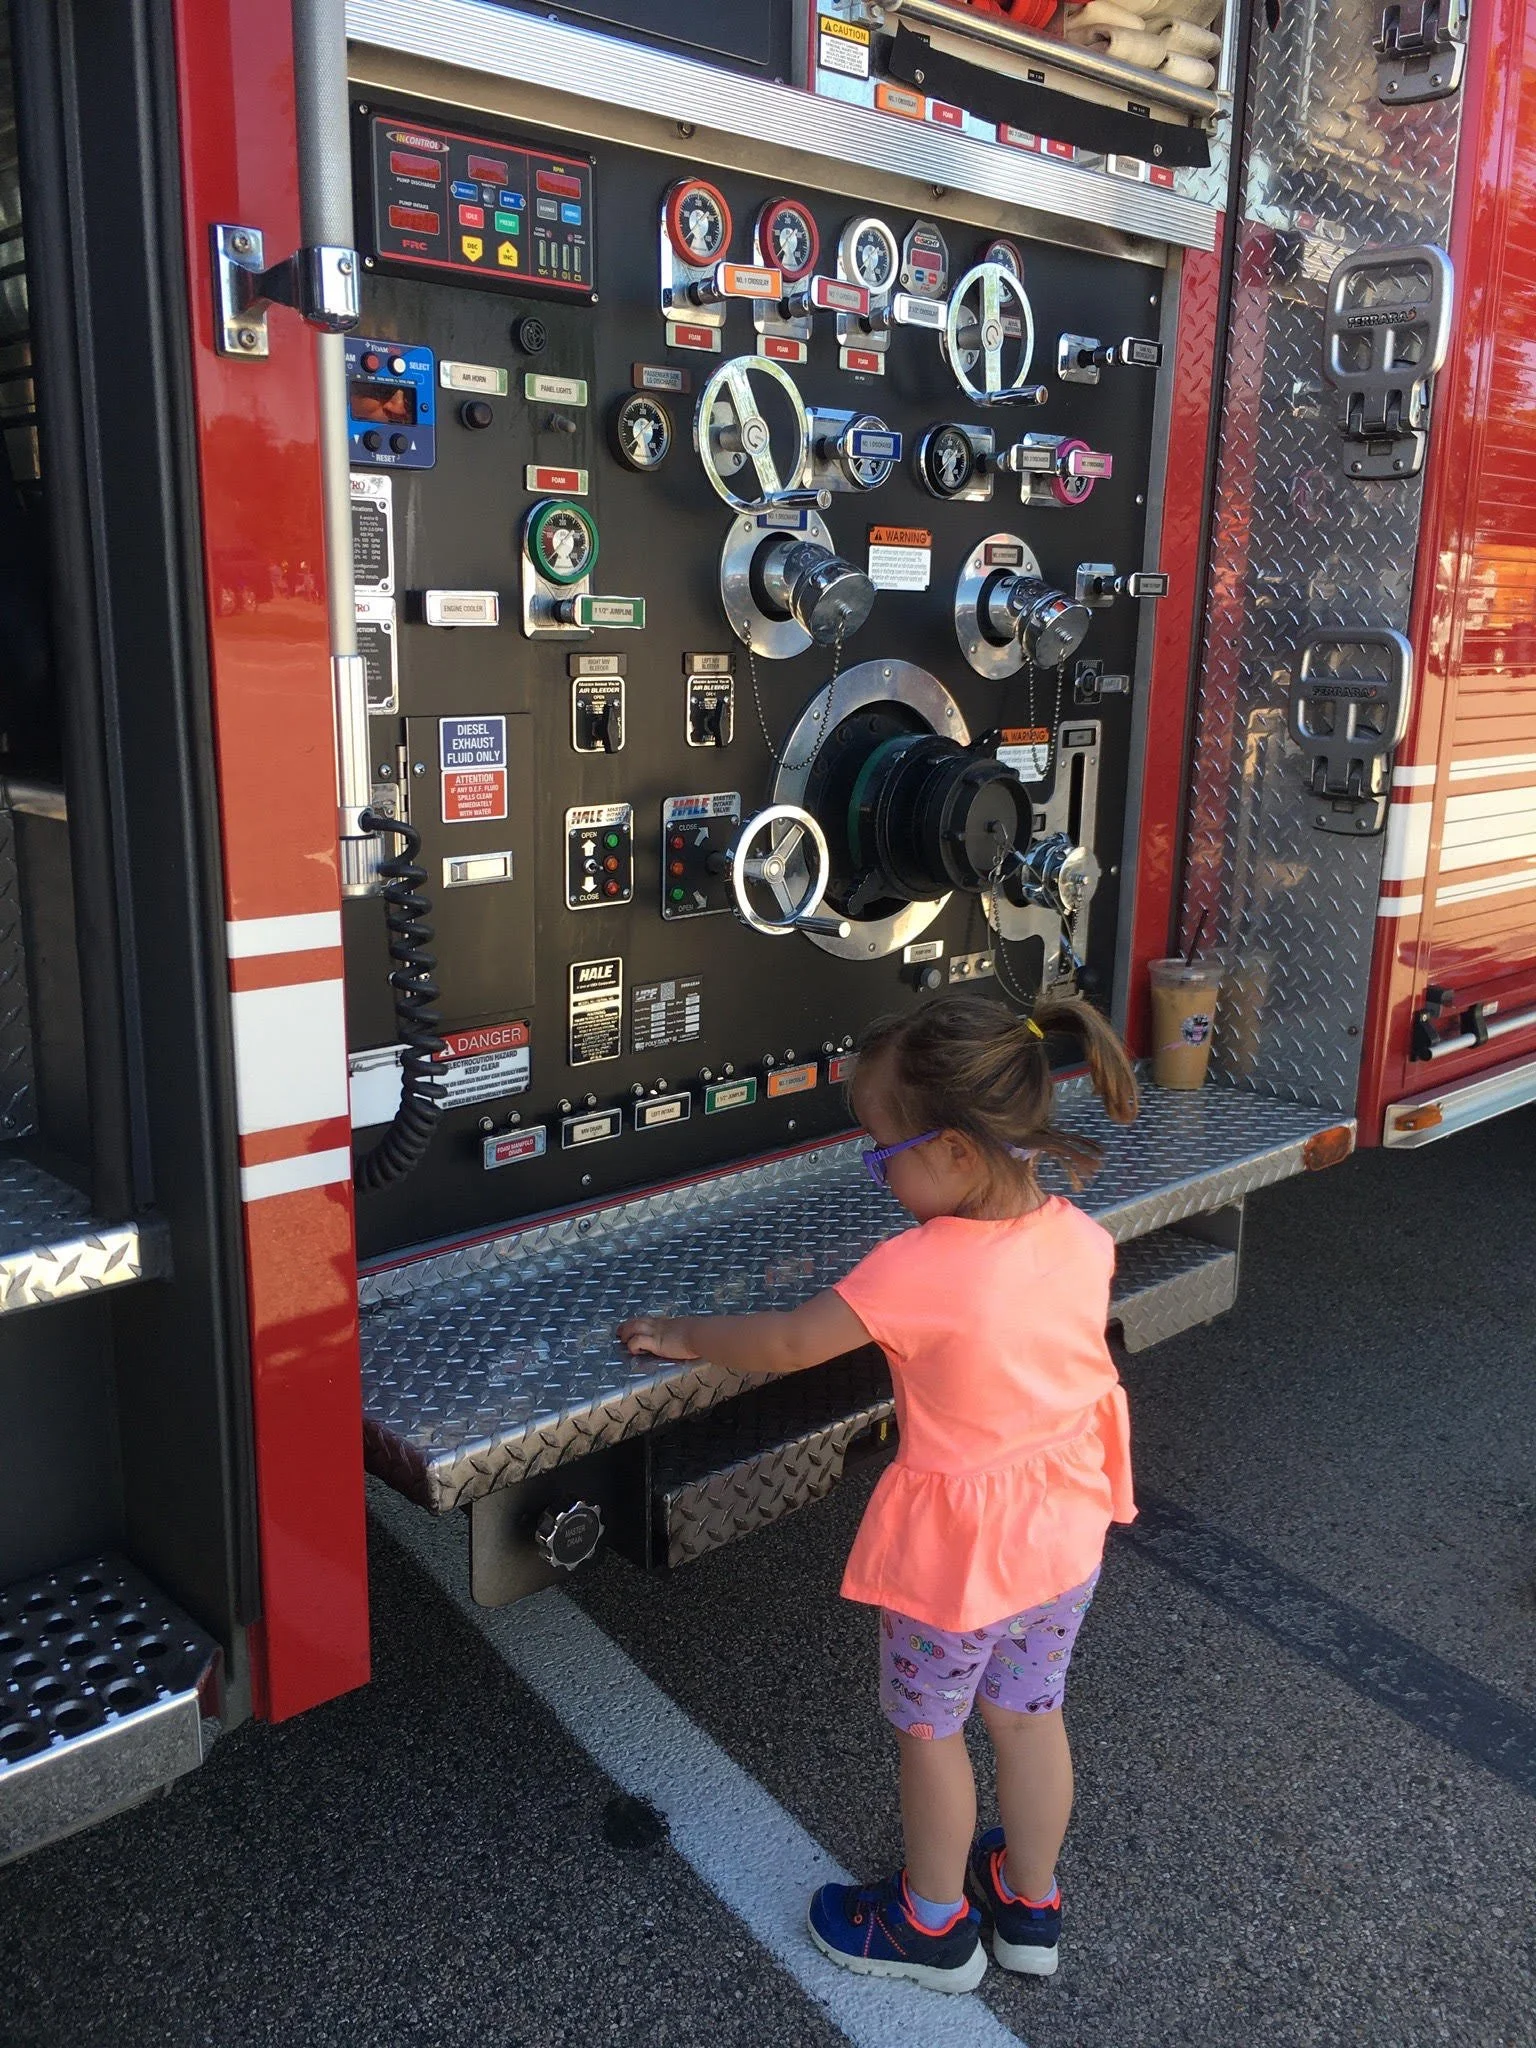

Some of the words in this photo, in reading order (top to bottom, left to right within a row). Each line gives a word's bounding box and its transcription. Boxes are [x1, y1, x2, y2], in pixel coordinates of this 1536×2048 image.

[832, 23, 866, 41] CAUTION
[942, 111, 953, 119] FOAM
[396, 134, 440, 150] INCONTROL
[397, 177, 410, 185] PUMP
[411, 179, 436, 189] DISCHARGE
[398, 199, 412, 207] PUMP
[413, 202, 429, 210] INTAKE
[466, 212, 478, 220] IDLE
[401, 239, 428, 251] FRC
[748, 278, 769, 286] CROSSLAY
[1348, 311, 1409, 328] FERRARA
[688, 333, 701, 342] FOAM
[777, 345, 789, 353] FOAM
[409, 361, 430, 371] SELECT
[857, 357, 868, 365] FOAM
[462, 373, 470, 381] AIR
[471, 374, 486, 384] HORN
[540, 384, 554, 394] PANEL
[554, 386, 572, 396] LIGHTS
[376, 454, 395, 462] RESET
[551, 476, 566, 484] FOAM
[885, 530, 927, 544] WARNING
[610, 608, 632, 616] JUMPLINE
[1313, 686, 1368, 698] FERRARA
[458, 724, 490, 736] DIESEL
[452, 736, 494, 750] EXHAUST
[447, 752, 474, 764] FLUID
[476, 750, 500, 762] ONLY
[456, 774, 494, 784] ATTENTION
[457, 786, 468, 794] ANY
[484, 784, 499, 792] FLUID
[458, 794, 476, 802] SPILLS
[458, 800, 492, 809] IMMEDIATELY
[474, 808, 492, 816] WATER
[712, 806, 730, 814] VALVE
[678, 824, 698, 832] CLOSE
[579, 893, 600, 902] CLOSE
[678, 904, 694, 912] OPEN
[579, 964, 614, 982] HALE
[458, 1027, 522, 1052] DANGER
[448, 1056, 494, 1070] ELECTROCUTION
[494, 1050, 518, 1060] HAZARD
[464, 1067, 480, 1075] KEEP
[481, 1062, 500, 1072] CLEAR
[650, 1110, 660, 1118] LEFT
[660, 1107, 675, 1116] INTAKE
[589, 1124, 603, 1133] DRAIN
[497, 1146, 510, 1154] FOAM
[511, 1140, 534, 1150] MANIFOLD
[508, 1148, 523, 1156] DRAIN
[909, 1633, 945, 1660] OMG
